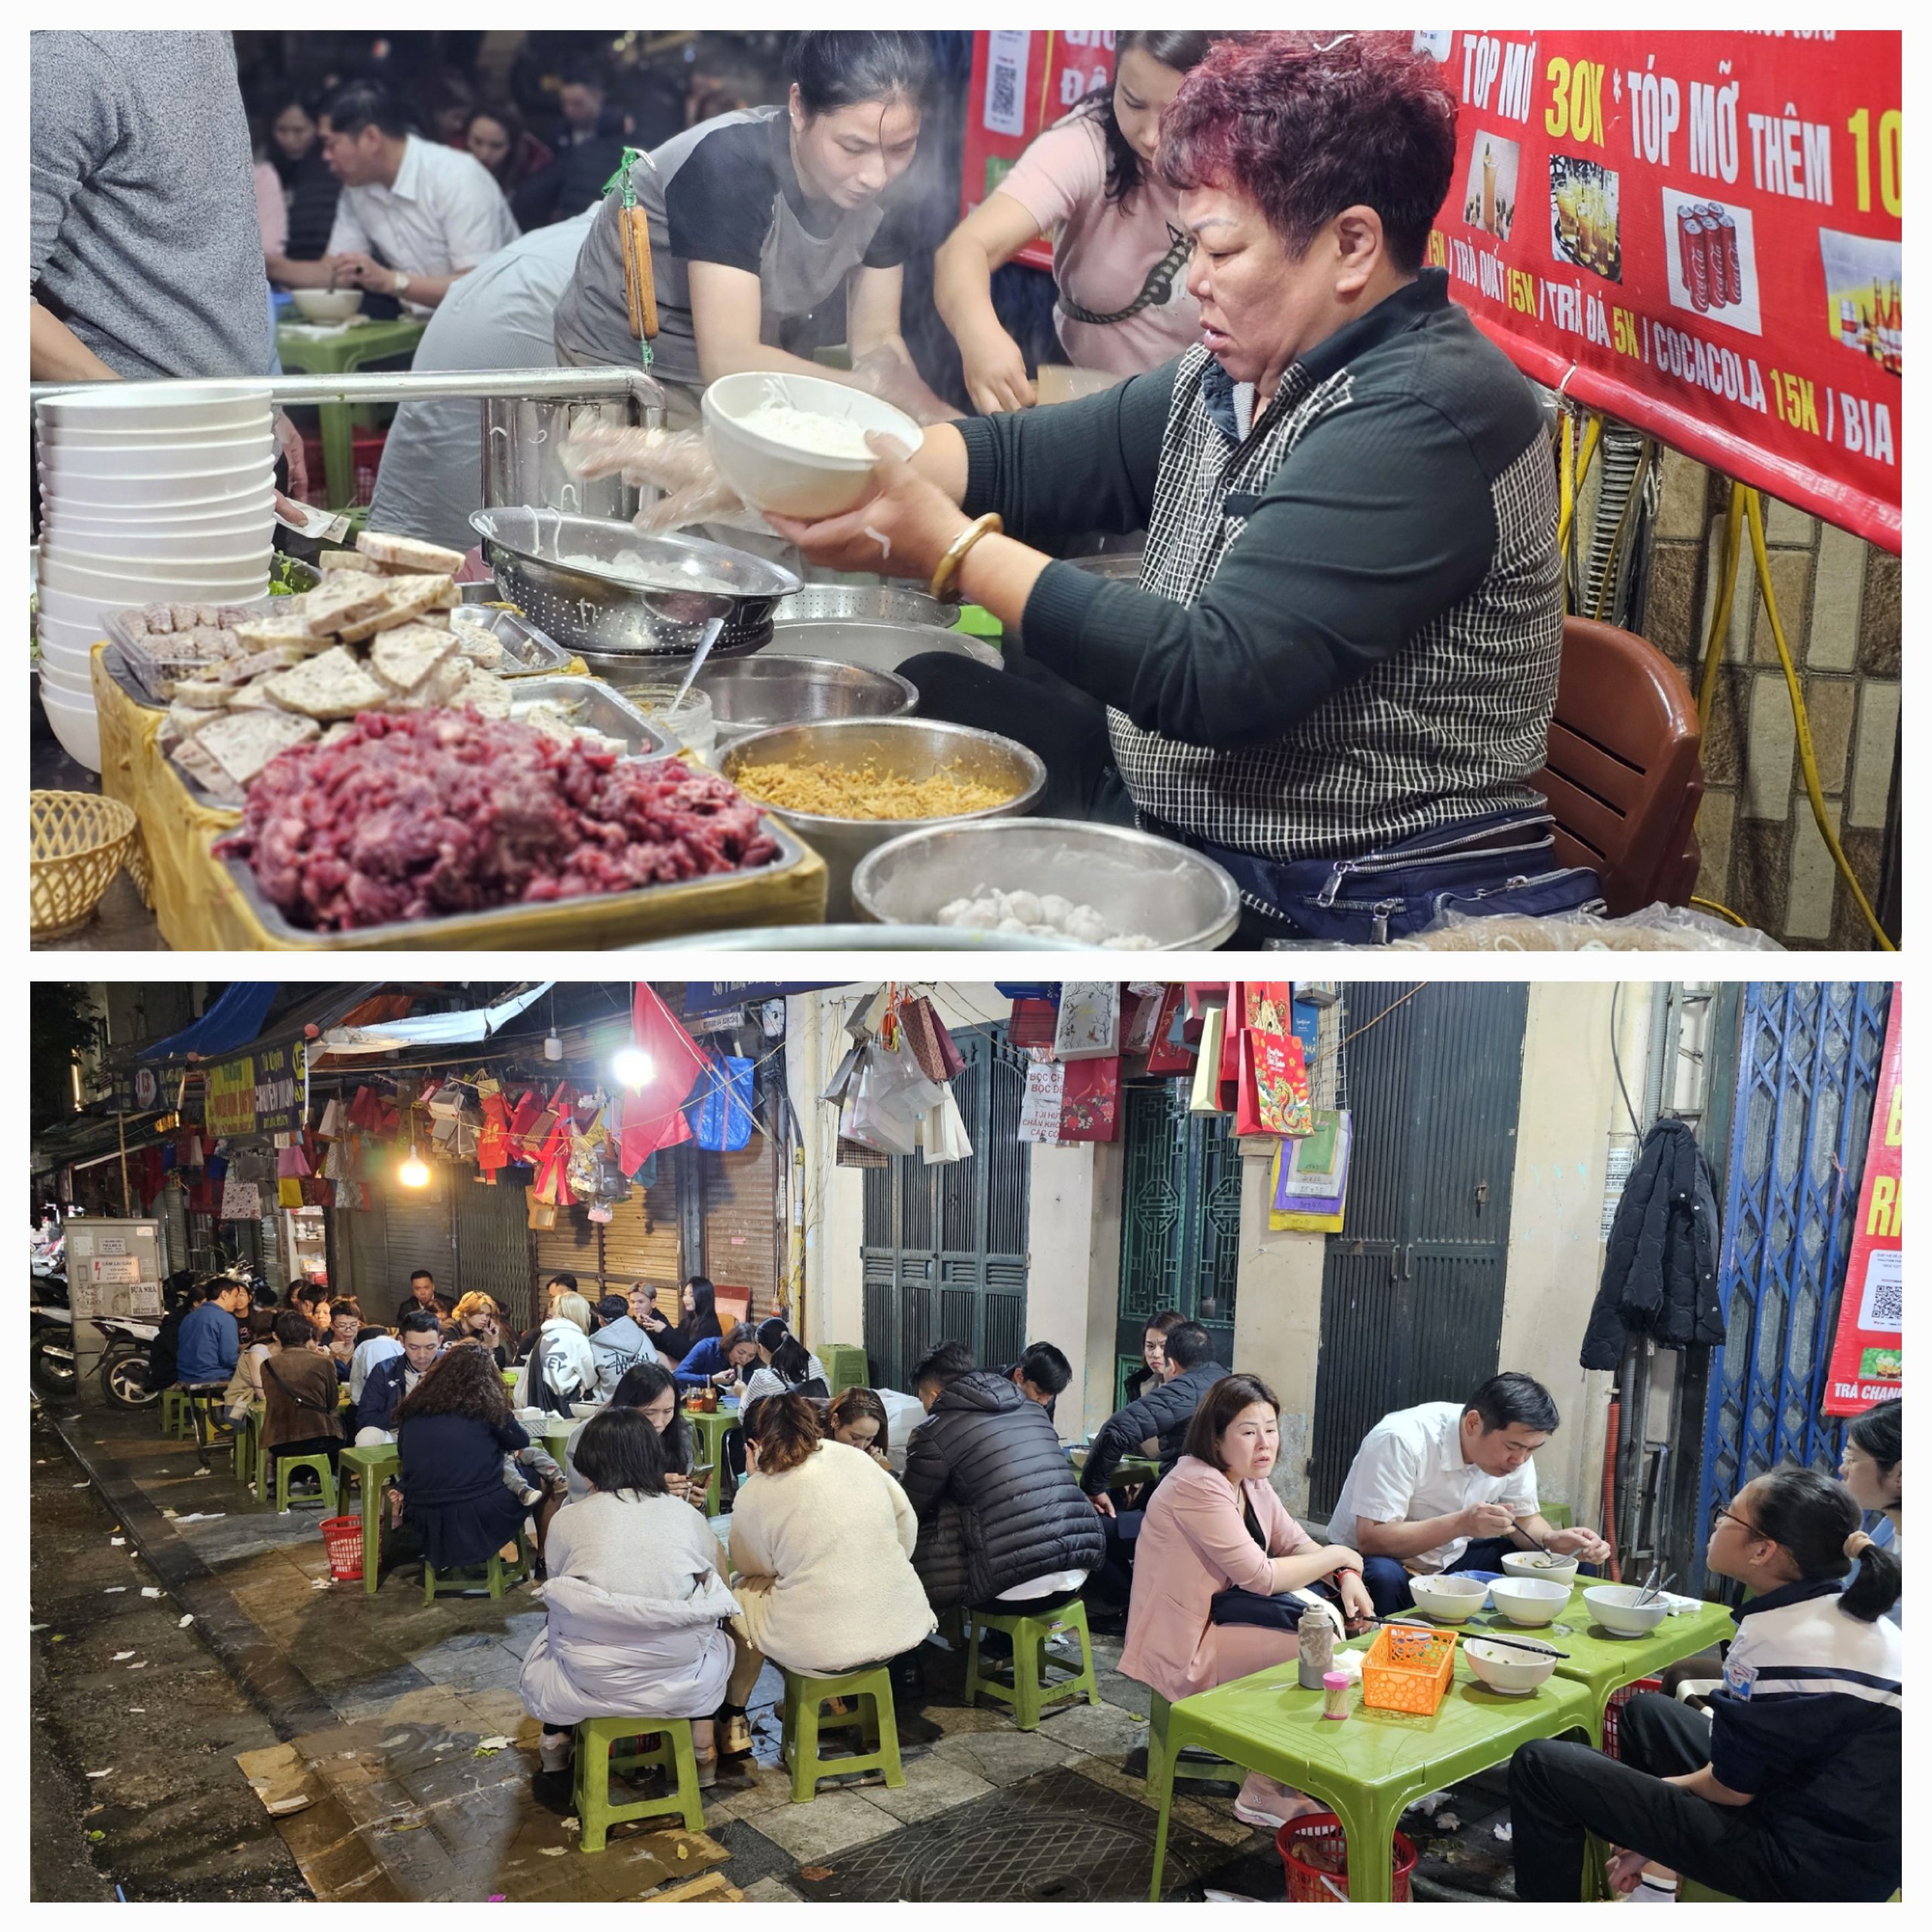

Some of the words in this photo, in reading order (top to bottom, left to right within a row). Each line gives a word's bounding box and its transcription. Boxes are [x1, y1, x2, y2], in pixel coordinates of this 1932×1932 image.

[1545, 57, 1605, 148] 30K
[1627, 54, 1680, 167] TÓP
[1690, 60, 1739, 184] MỠ
[1748, 102, 1833, 206] THÊM
[1454, 236, 1478, 288] TRÀ
[1506, 267, 1537, 317] 15K
[1546, 278, 1583, 337] TRÀ
[1586, 290, 1612, 349] ĐÁ
[1613, 307, 1639, 360] 5K
[1653, 321, 1767, 414] COCACOLA
[1770, 368, 1820, 435] 15K
[1840, 392, 1896, 466] BIA
[1029, 1073, 1048, 1082] BỌC
[1031, 1084, 1051, 1094] BỌC
[1835, 1380, 1858, 1399] TRÀ
